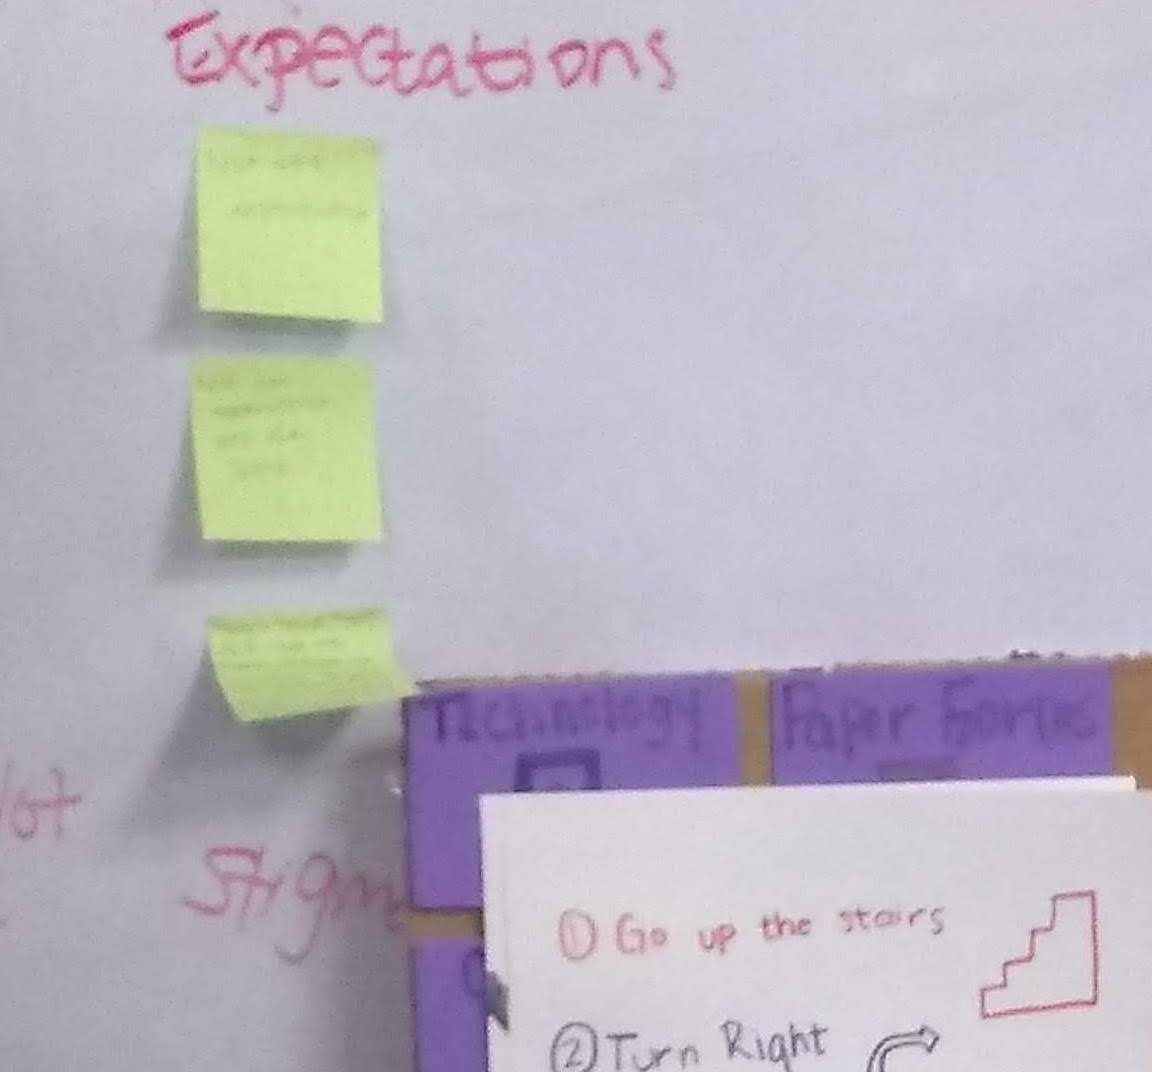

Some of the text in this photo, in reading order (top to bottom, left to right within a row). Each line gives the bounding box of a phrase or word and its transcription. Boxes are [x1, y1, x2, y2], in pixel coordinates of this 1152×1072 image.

[166, 10, 677, 113] Expectations
[179, 846, 405, 966] Stigm
[615, 911, 669, 955] Go
[699, 921, 738, 956] up
[758, 911, 813, 942] the
